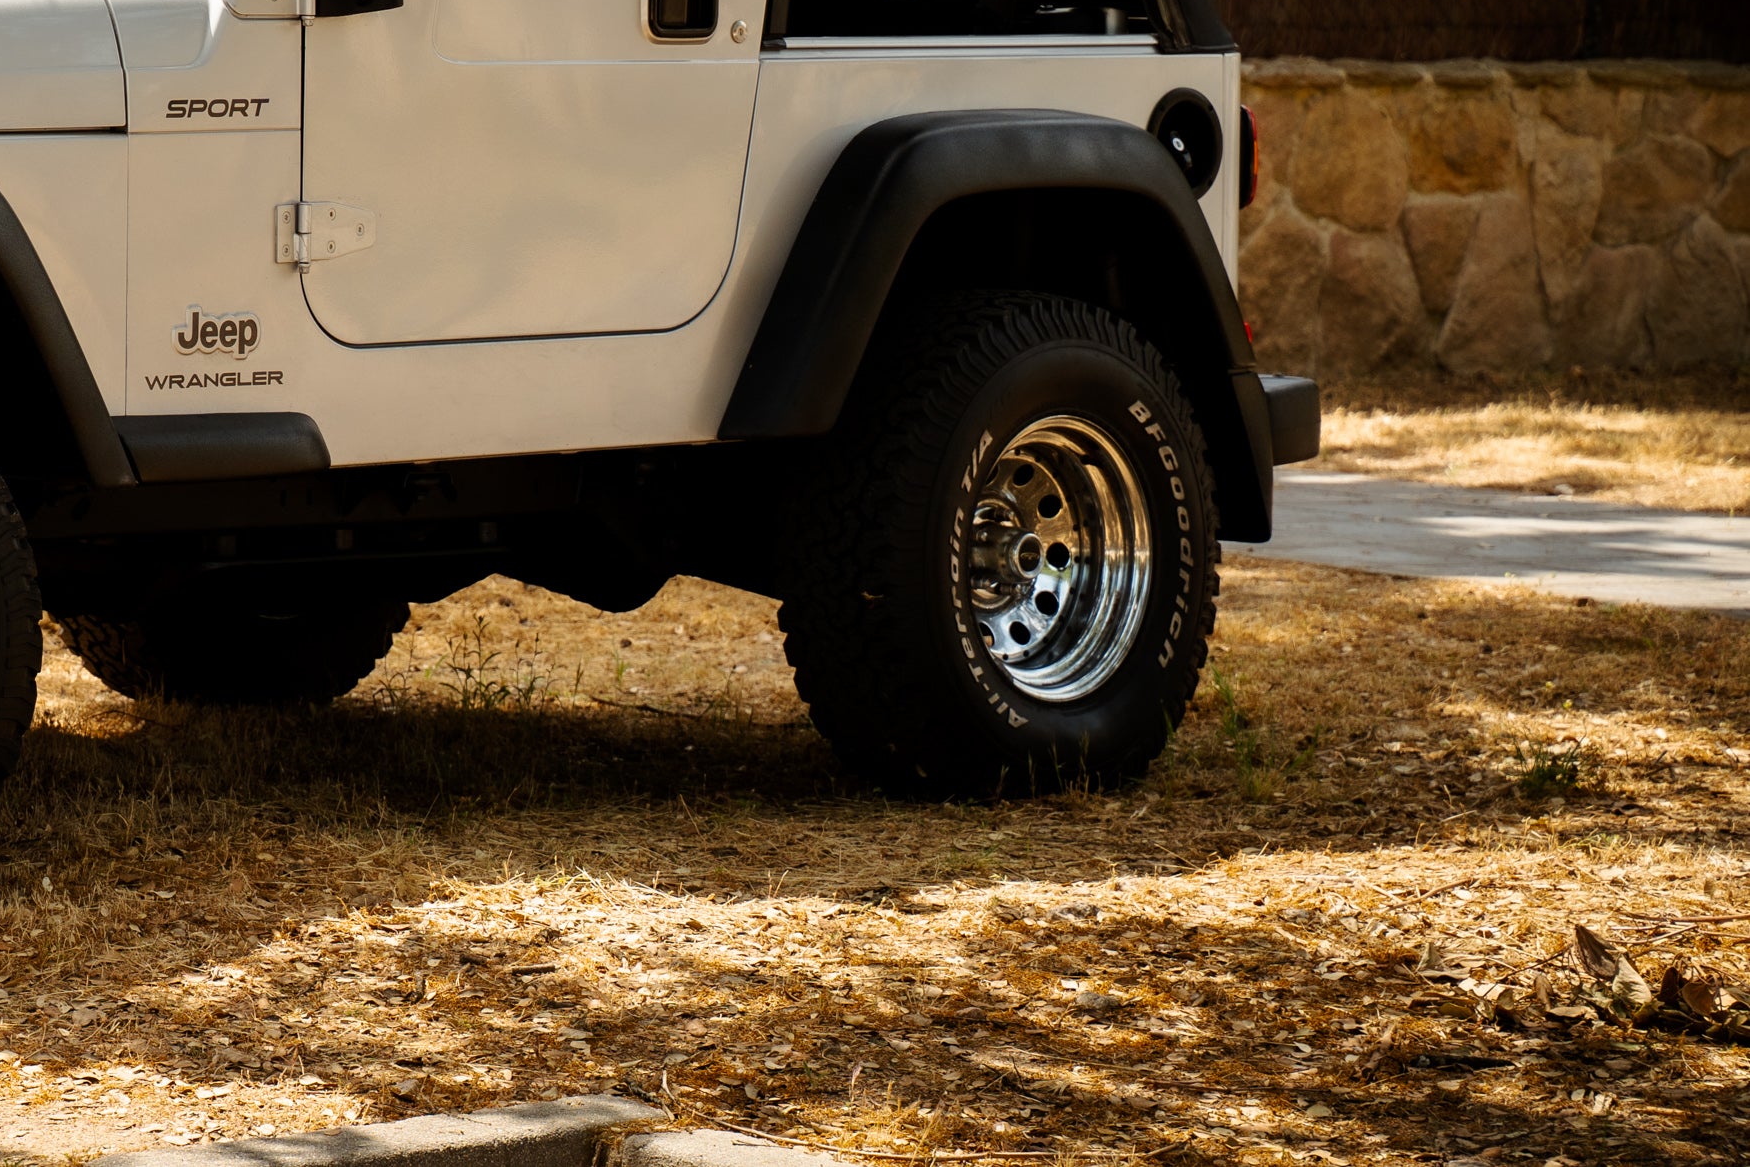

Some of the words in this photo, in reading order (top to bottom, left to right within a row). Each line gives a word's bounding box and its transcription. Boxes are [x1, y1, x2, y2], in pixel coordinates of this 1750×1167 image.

[165, 98, 270, 118] SPORT
[177, 311, 258, 354] Jeep
[144, 370, 284, 391] WRANGLER
[961, 429, 993, 494] T/A
[1127, 399, 1194, 669] BFGoodrich
[950, 506, 1029, 729] All-Terrain
